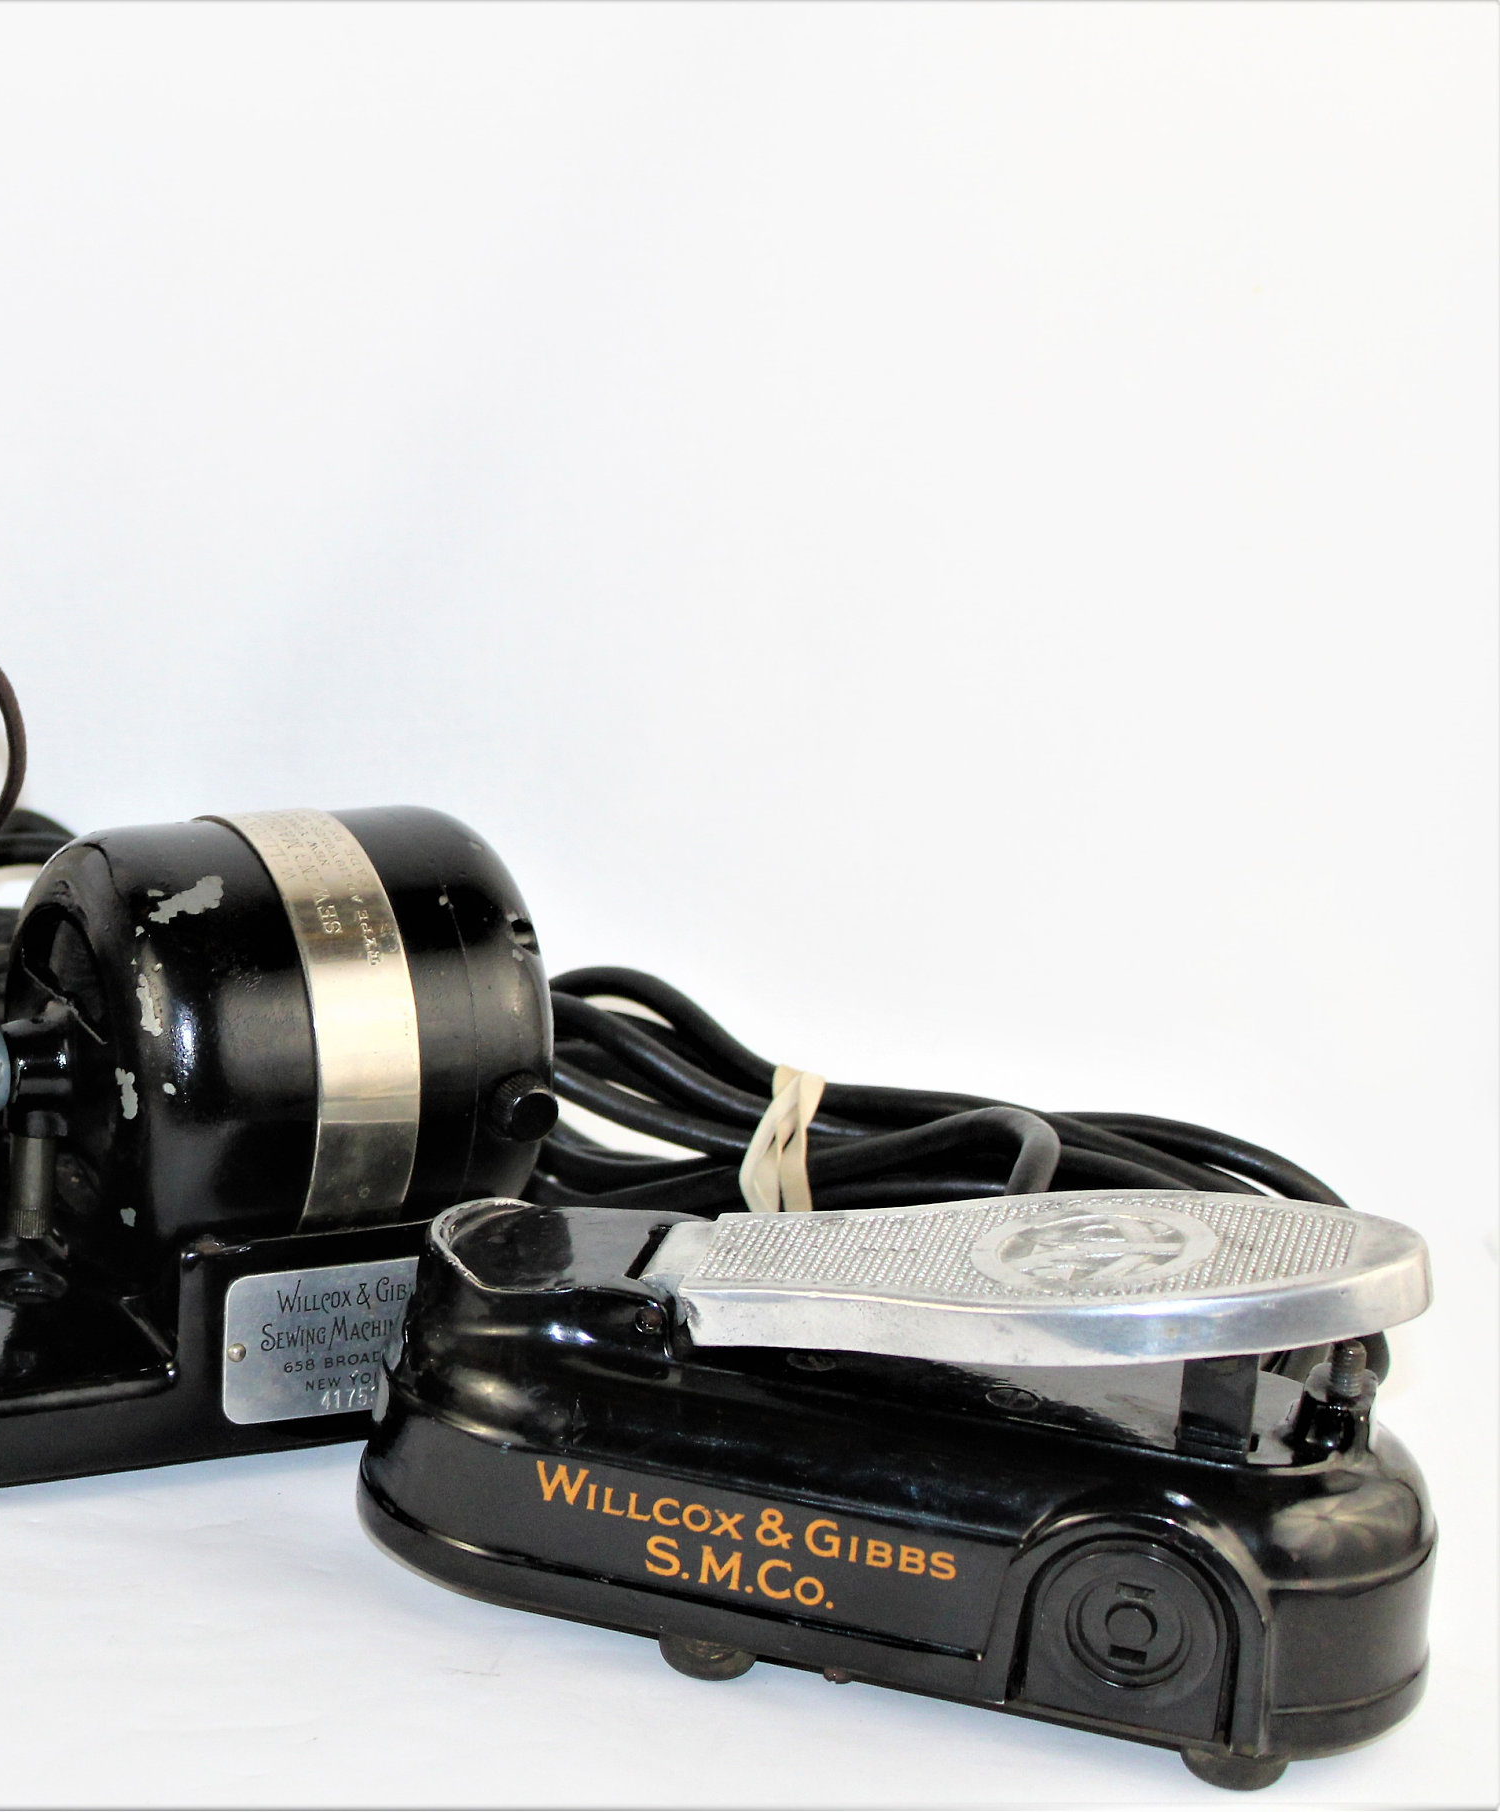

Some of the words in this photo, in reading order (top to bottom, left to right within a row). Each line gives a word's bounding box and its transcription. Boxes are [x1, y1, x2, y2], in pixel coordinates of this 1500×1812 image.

[277, 1280, 352, 1313] WILLCOX
[356, 1282, 371, 1310] &
[376, 1276, 412, 1303] GIB
[261, 1323, 326, 1353] SEWING
[283, 1361, 315, 1373] 658
[305, 1377, 341, 1392] NEW
[536, 1460, 744, 1541] WILLCOX
[755, 1508, 794, 1550] &
[804, 1519, 958, 1582] GIBBS
